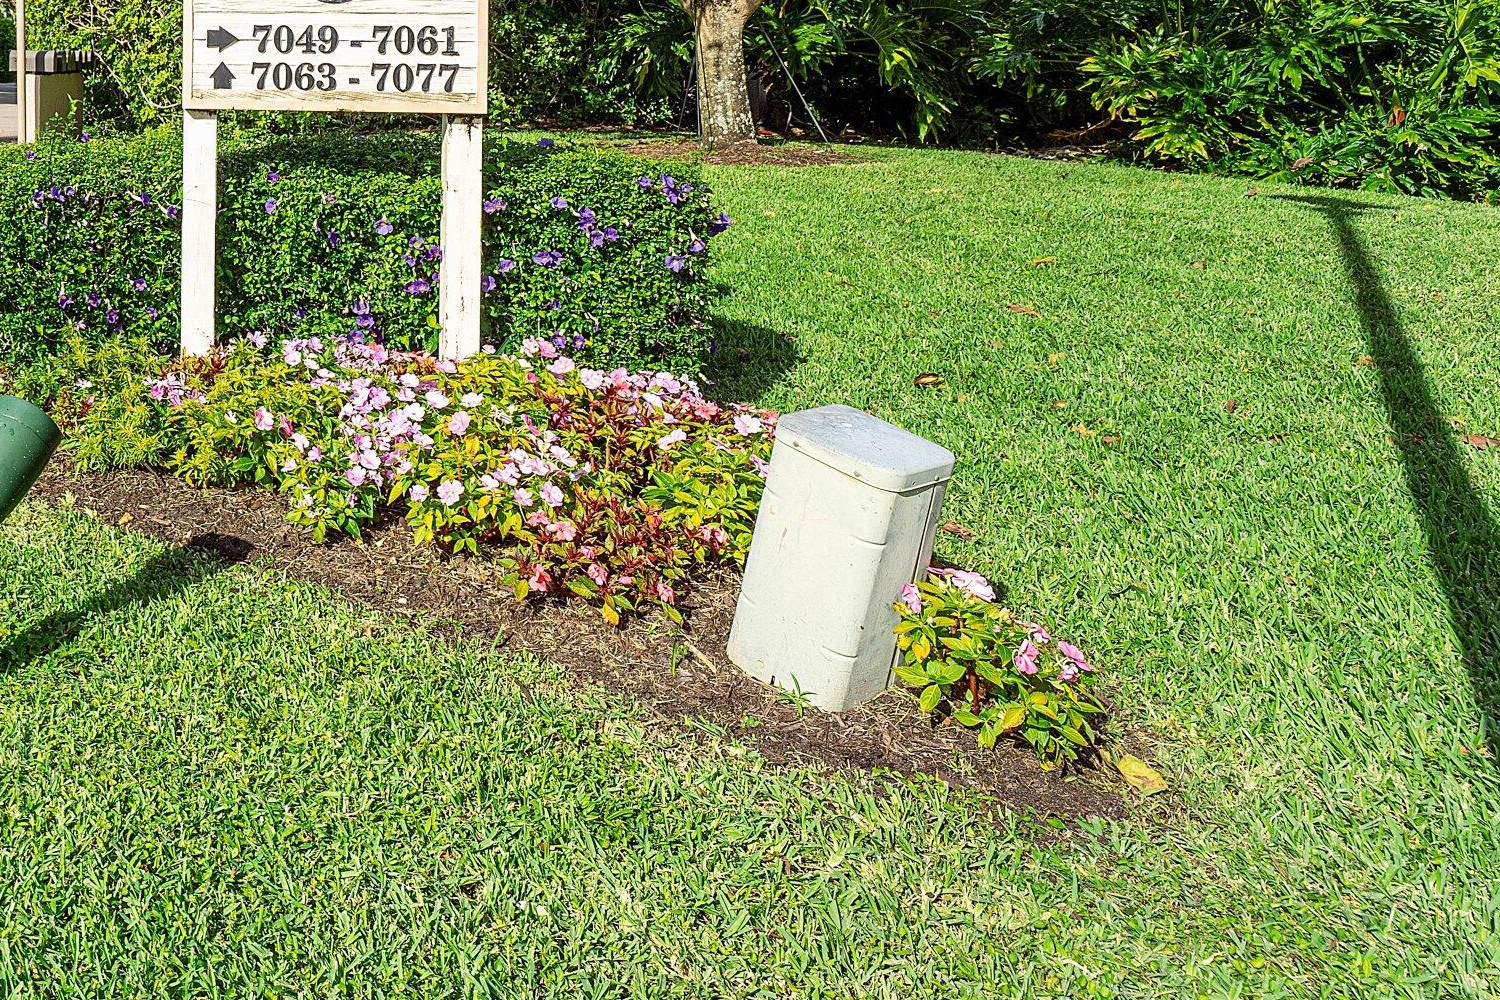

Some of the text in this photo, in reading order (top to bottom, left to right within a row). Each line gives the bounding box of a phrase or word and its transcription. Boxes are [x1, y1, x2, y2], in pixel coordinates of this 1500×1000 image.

[252, 25, 339, 54] 7049
[372, 25, 460, 56] 7061
[251, 62, 337, 91] 7063
[371, 63, 460, 93] 7077
